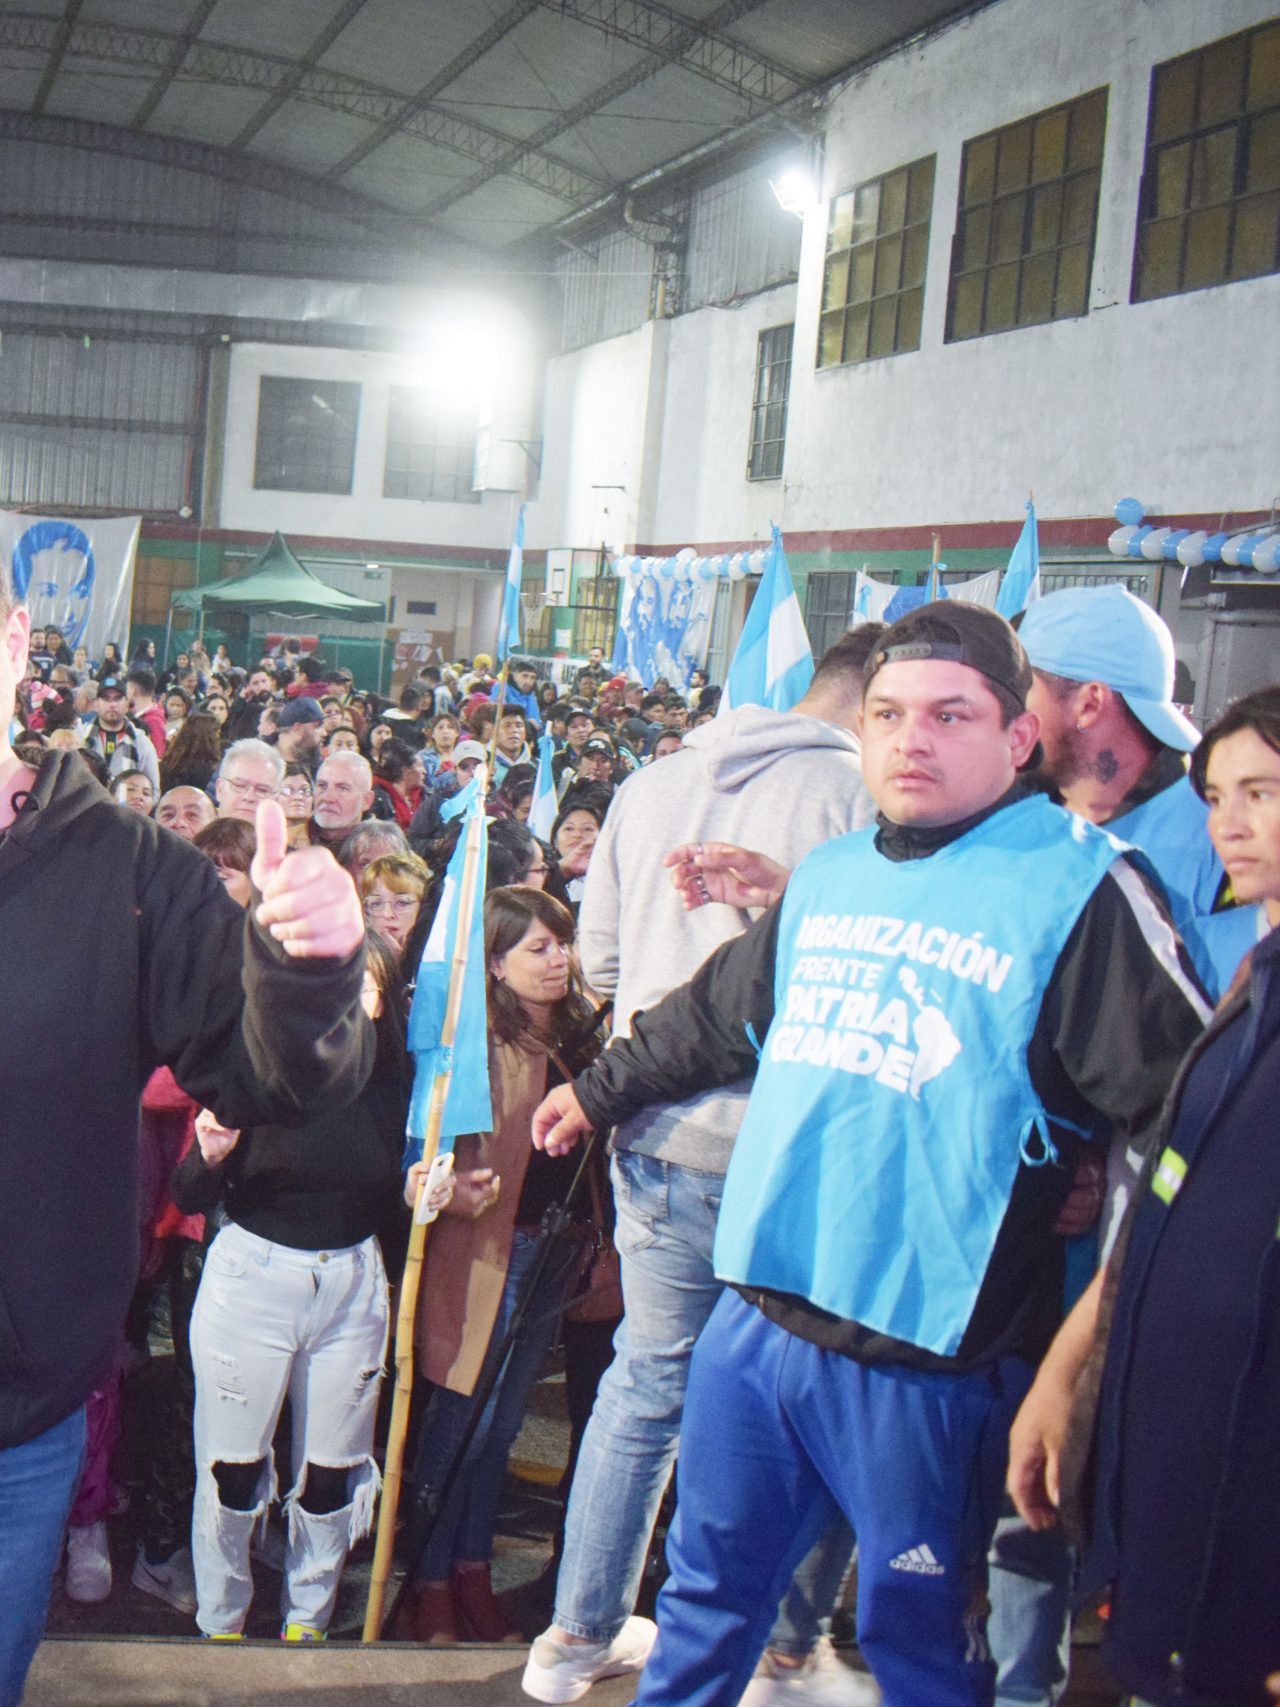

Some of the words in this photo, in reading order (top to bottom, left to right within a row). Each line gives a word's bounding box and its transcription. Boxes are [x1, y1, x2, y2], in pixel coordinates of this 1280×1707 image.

[791, 955, 884, 989] FRENTE
[783, 984, 909, 1046] PATRIA
[889, 1558, 945, 1575] adidas
